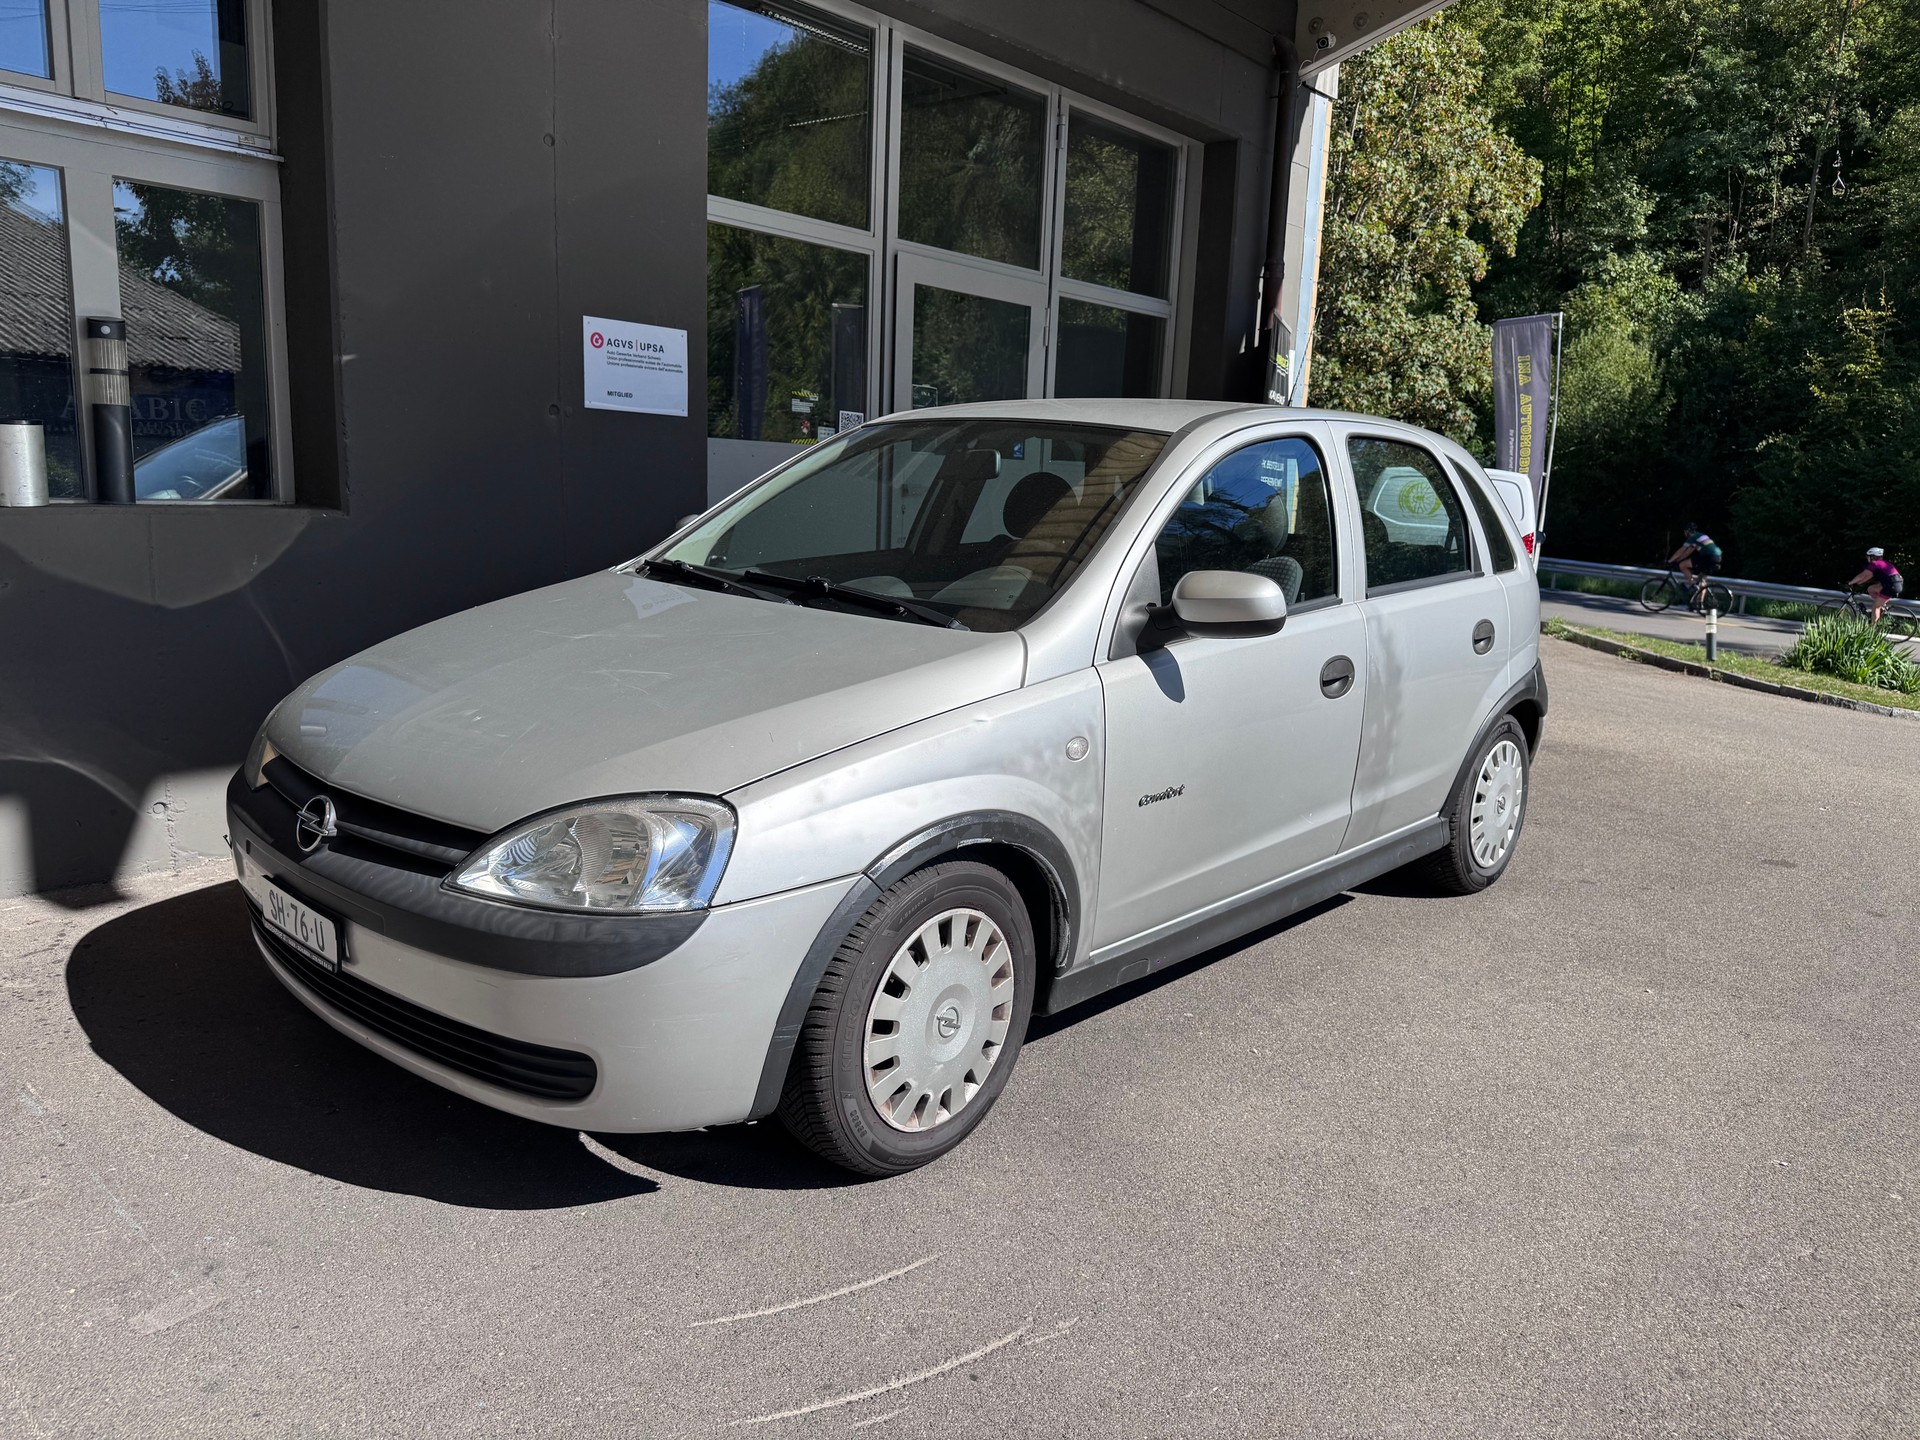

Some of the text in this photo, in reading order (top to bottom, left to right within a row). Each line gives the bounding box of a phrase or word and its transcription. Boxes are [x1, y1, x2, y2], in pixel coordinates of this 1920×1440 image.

[606, 338, 664, 353] AGVS UPSA
[1518, 355, 1531, 386] INA
[607, 390, 633, 398] MITGLIED
[1138, 783, 1186, 808] Comfort
